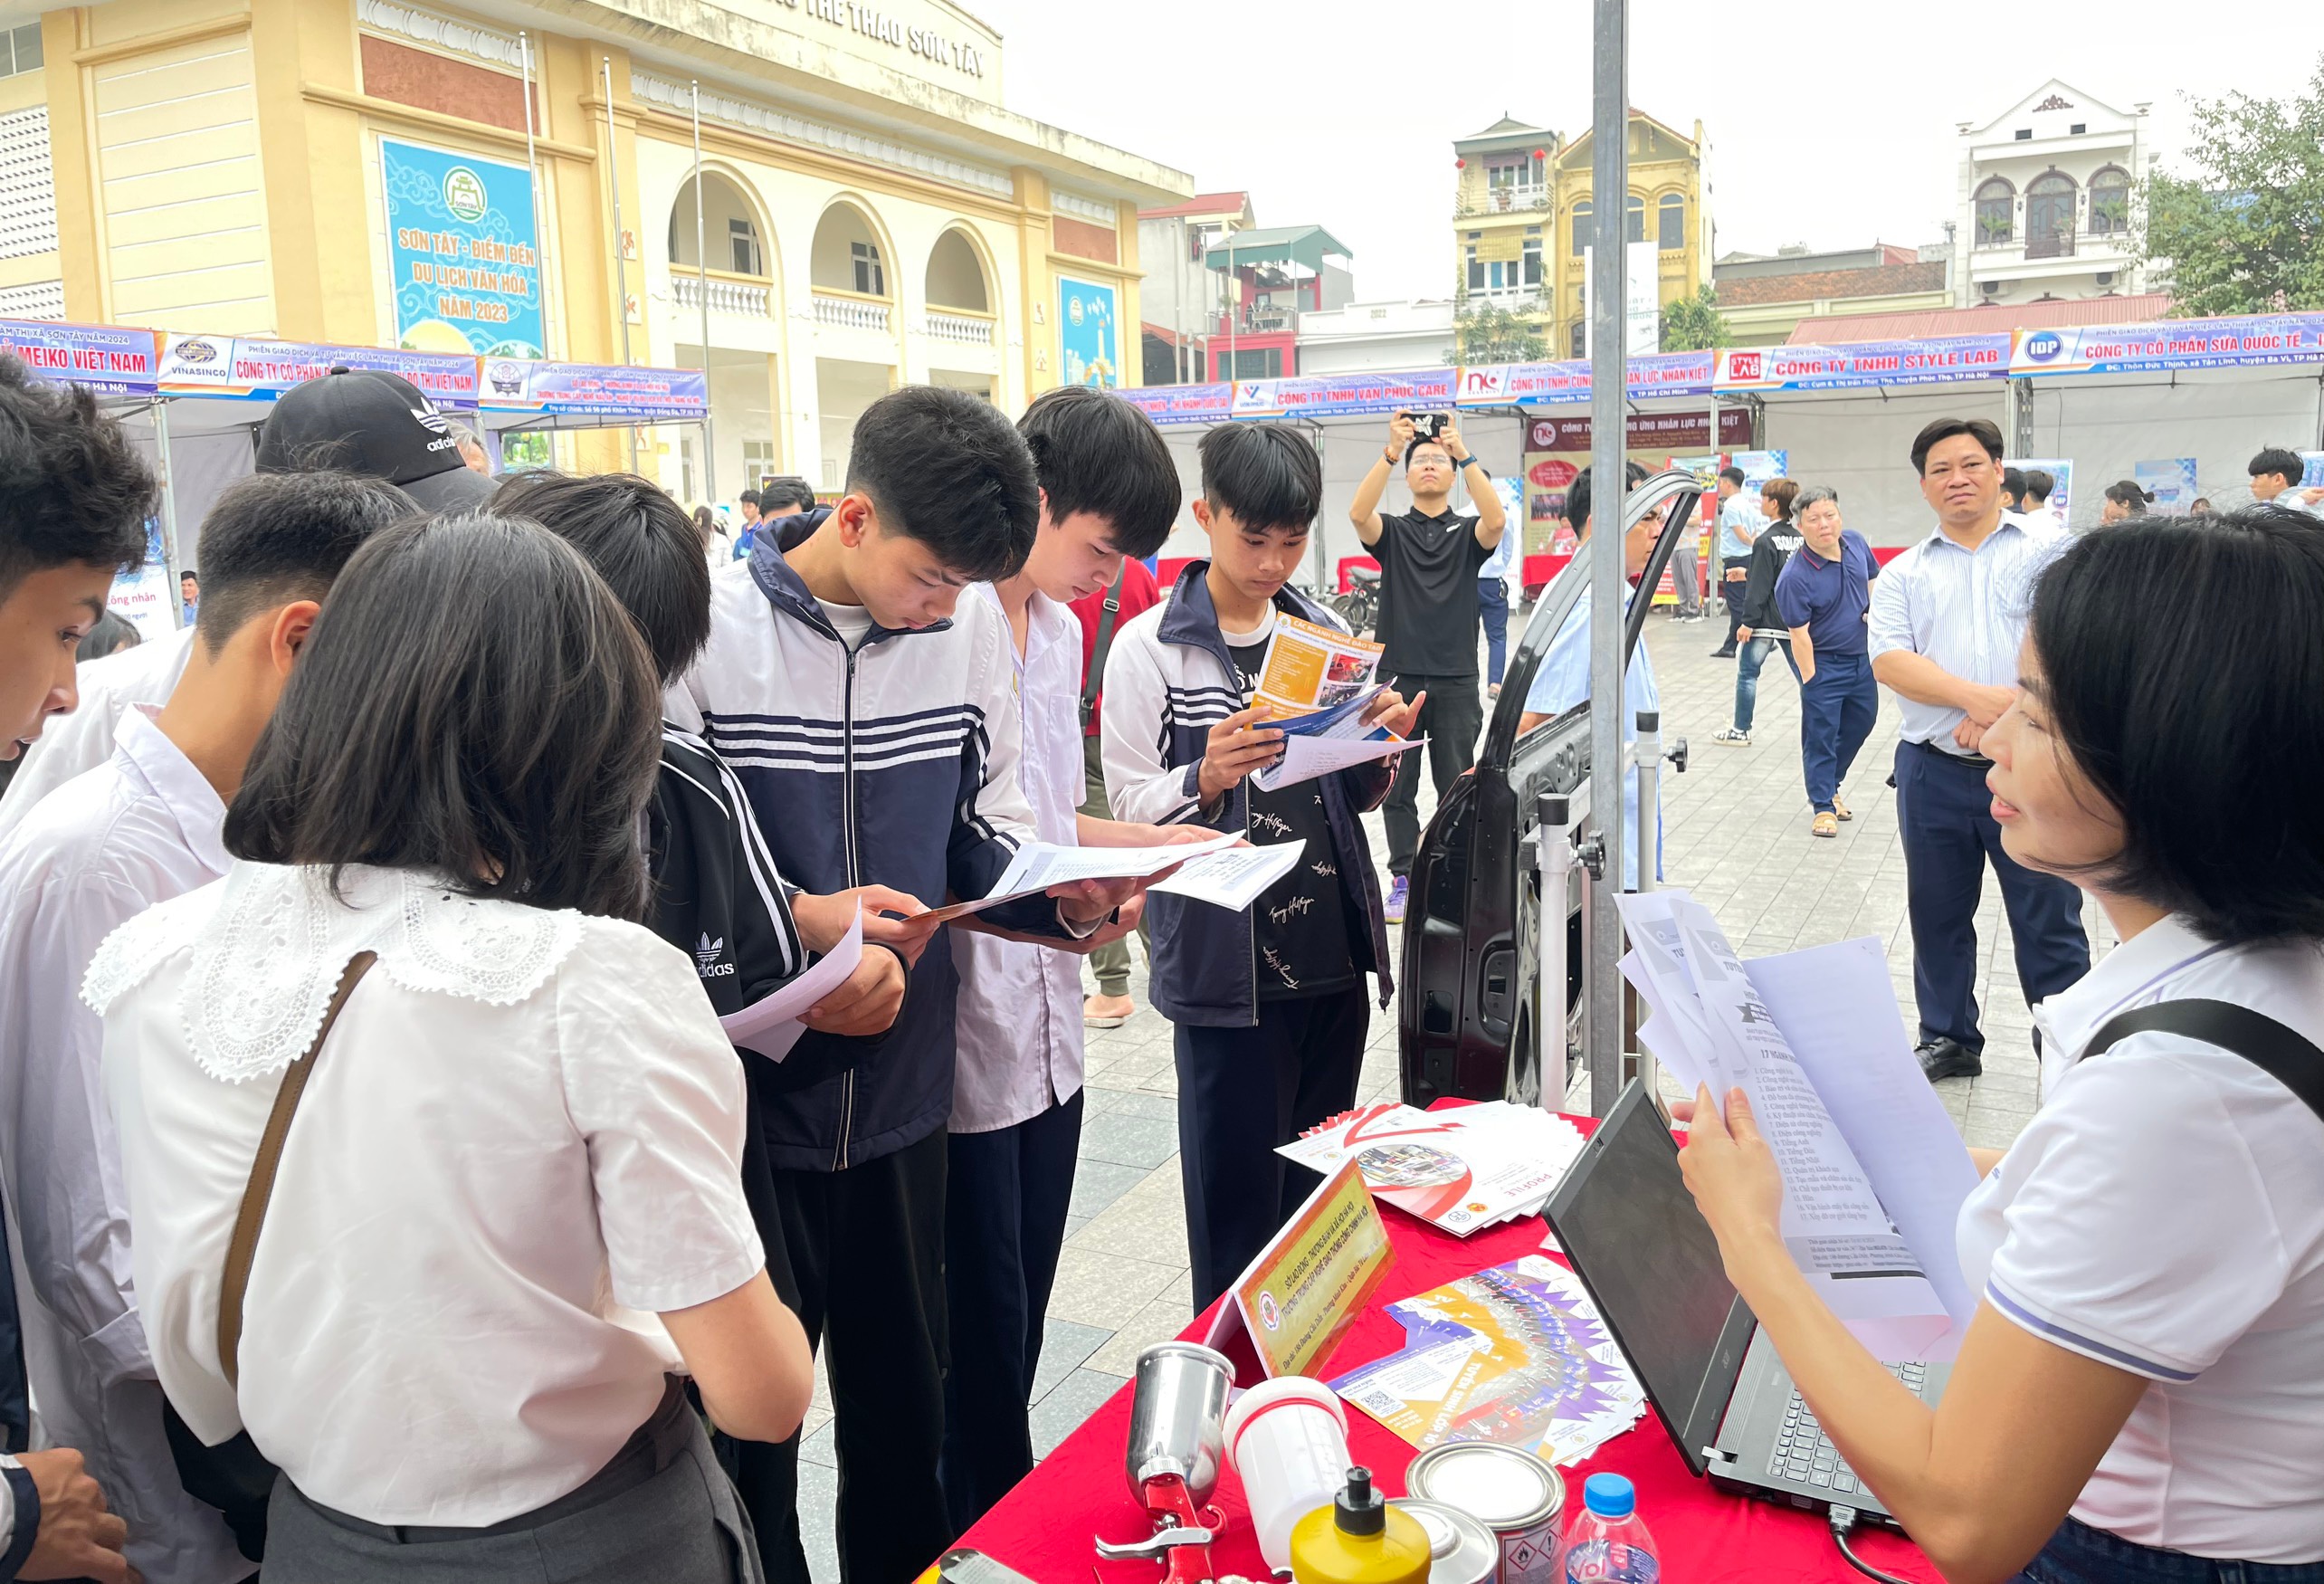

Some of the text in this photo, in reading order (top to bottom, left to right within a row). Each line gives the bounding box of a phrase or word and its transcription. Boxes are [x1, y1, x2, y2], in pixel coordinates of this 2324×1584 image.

[847, 1, 901, 47] THAO
[398, 228, 535, 266] SƠN TÂY ĐIỂM ĐẾN
[414, 262, 527, 294] DU LỊCH VĂN HÓA
[439, 296, 509, 322] NĂM 2023
[48, 331, 66, 339] SƠN
[69, 332, 84, 341] TÂY
[87, 334, 106, 342] NĂM
[108, 336, 129, 344] 2024
[2031, 341, 2057, 355] IDP
[2086, 329, 2302, 358] CÔNG TY CỔ PHẦN SỮA QUỐC TẾ
[18, 347, 146, 374] MEIKO VIỆT NAM
[249, 346, 270, 354] PHIÊN
[1731, 356, 1760, 365] STYLE
[172, 367, 226, 377] VINASINCO
[1731, 366, 1759, 377] LAB
[1776, 349, 1998, 376] CÔNG TY TNHH STYLE LAB
[2123, 362, 2142, 370] Thôn
[2163, 360, 2187, 368] Thịnh,
[2240, 357, 2264, 366] huyện
[2307, 353, 2318, 361] Hà
[236, 358, 263, 378] CÔNG
[266, 363, 277, 380] TY
[280, 360, 294, 381] CỔ
[435, 371, 452, 393] VIỆT
[454, 377, 471, 391] NAM
[1511, 377, 1533, 391] CÔNG
[1536, 377, 1545, 390] TY
[1548, 377, 1569, 388] TNHH
[1643, 369, 1658, 384] LỰC
[1689, 366, 1708, 382] KIỆT
[1976, 371, 1989, 379] Nội
[92, 382, 128, 393] Hà Nội
[1278, 391, 1307, 406] CÔNG
[1310, 392, 1323, 404] TY
[1326, 390, 1355, 402] TNHH
[1418, 385, 1448, 396] CARE
[108, 594, 156, 606] ông nhân
[1293, 620, 1306, 630] CÁC
[1308, 625, 1331, 637] NGÀNH
[1332, 632, 1351, 644] NGHỀ
[698, 961, 735, 978] didas
[1503, 1172, 1552, 1198] PROFILE
